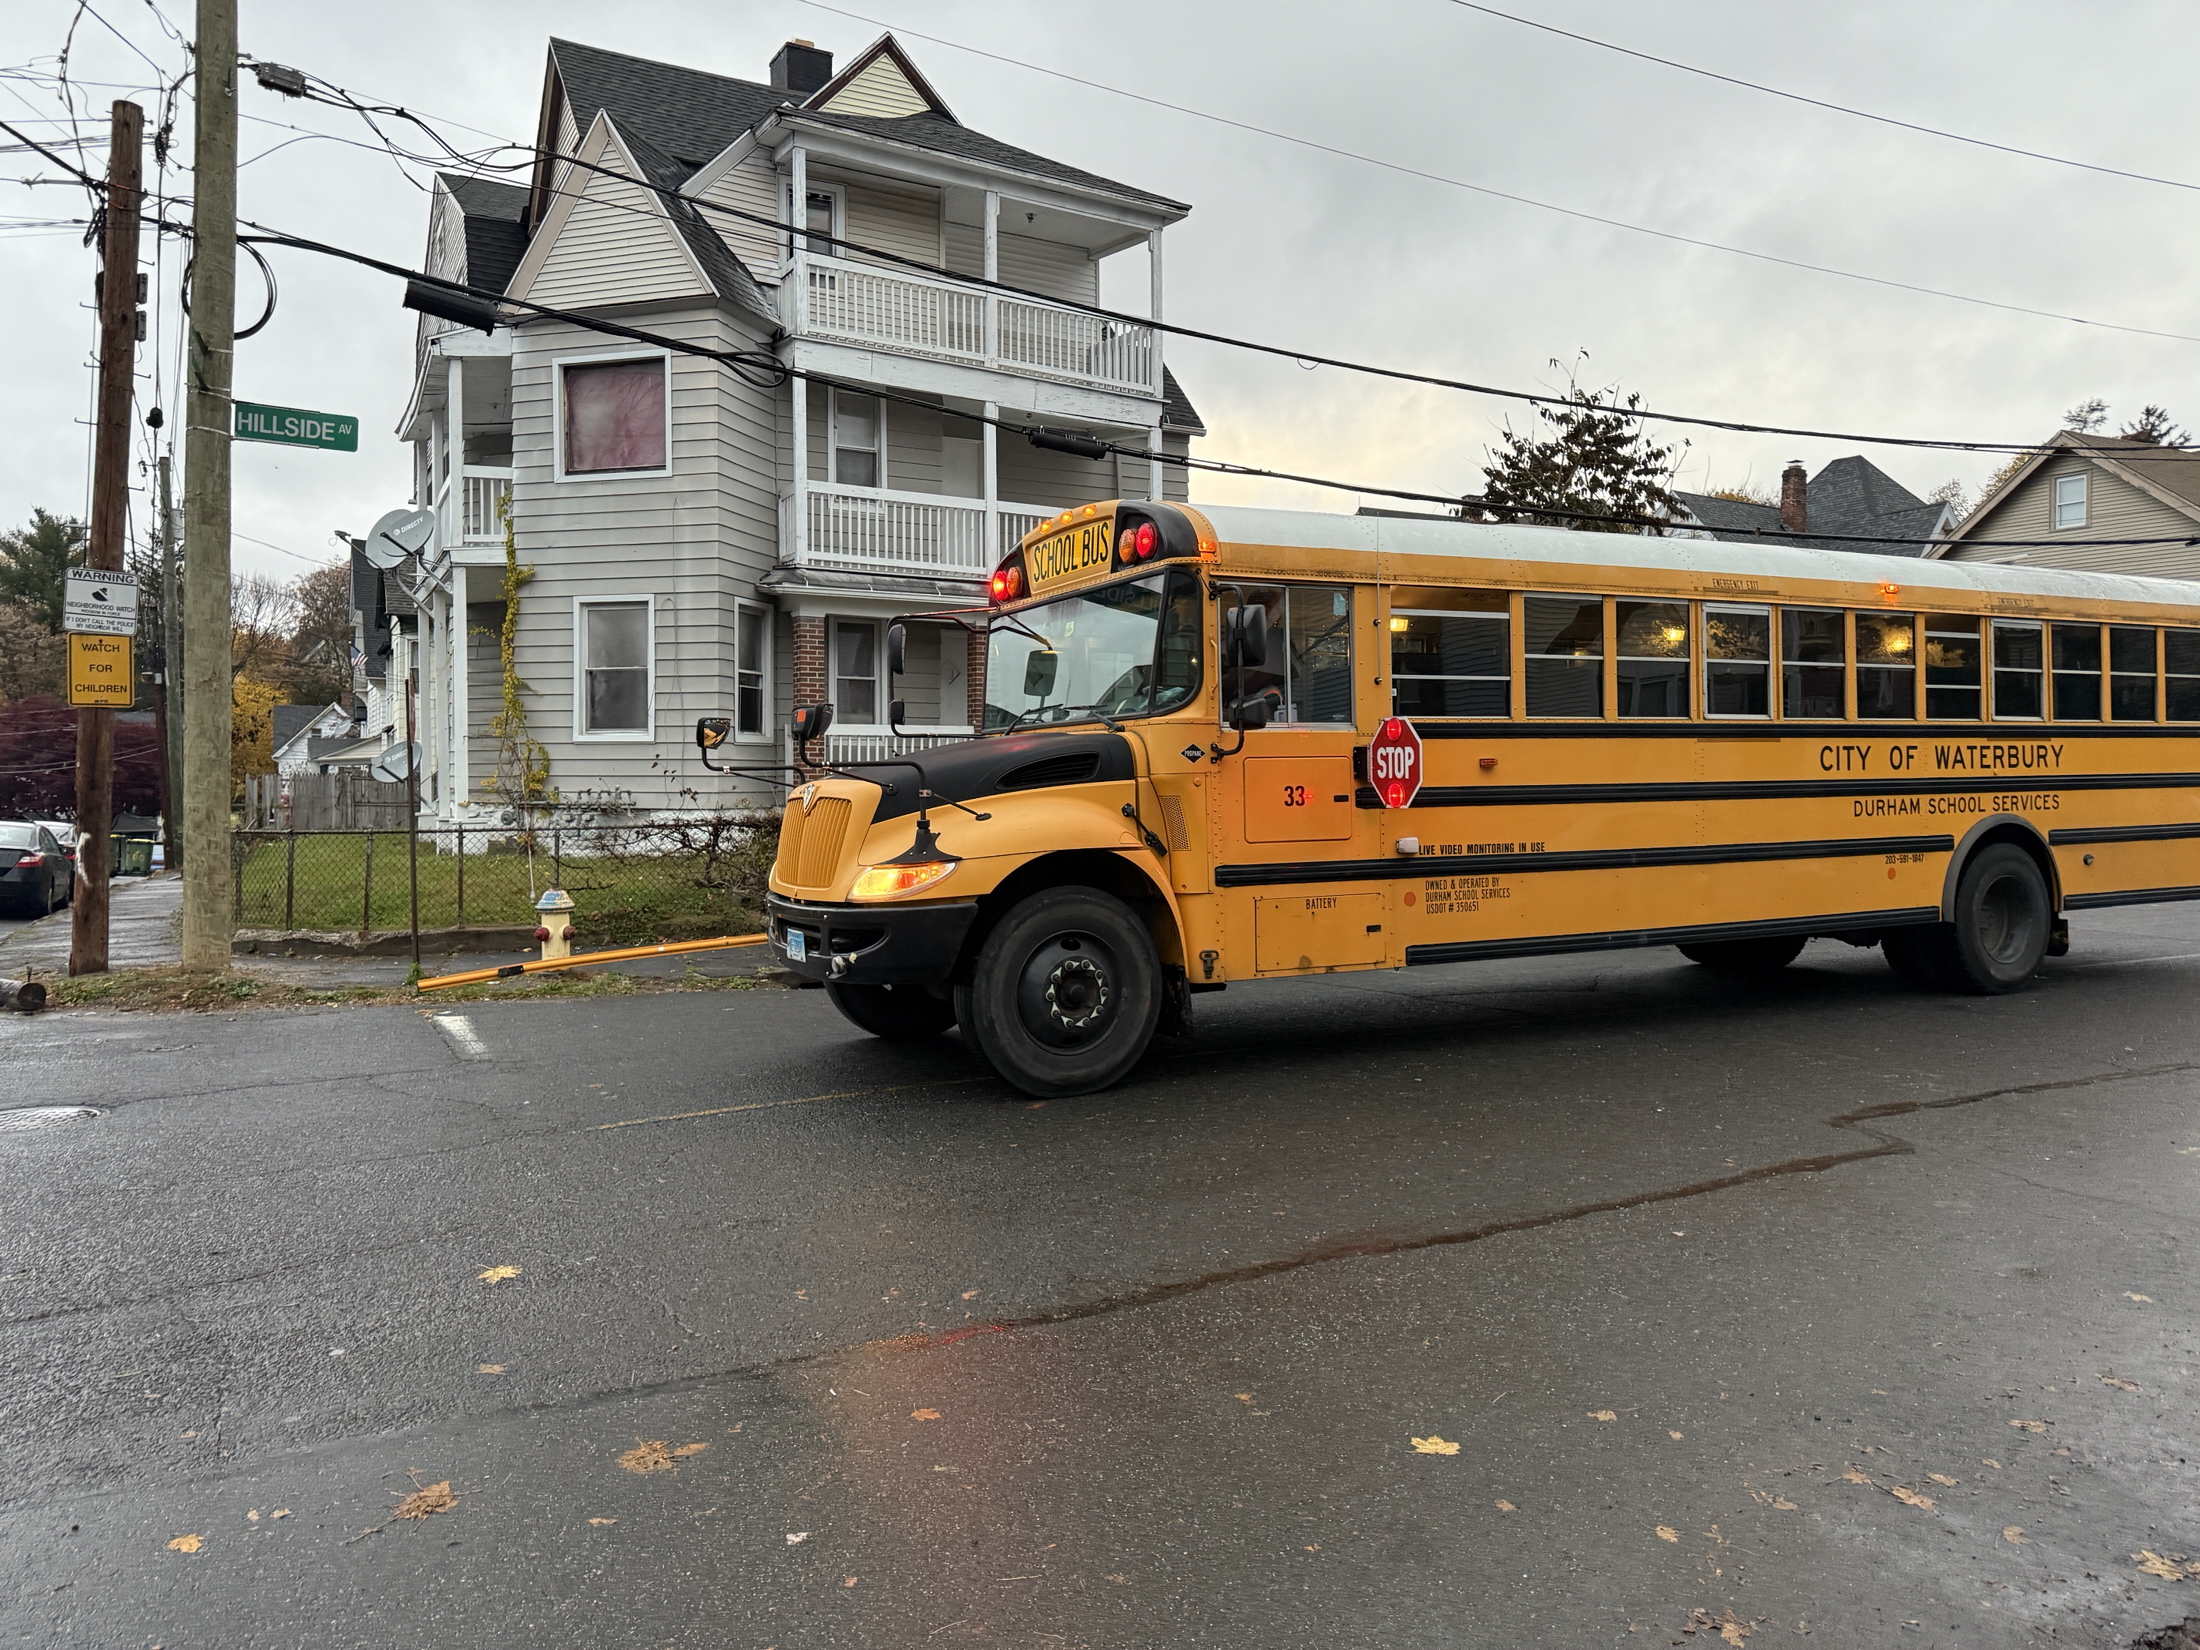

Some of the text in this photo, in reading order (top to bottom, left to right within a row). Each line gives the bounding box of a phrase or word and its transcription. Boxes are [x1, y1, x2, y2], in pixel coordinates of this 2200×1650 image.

[237, 411, 352, 441] HILLSIDE AV
[1033, 521, 1109, 582] SCHOOL BUS
[72, 569, 134, 584] WARNING
[1712, 578, 1759, 590] EMERGENCY EXIT
[66, 601, 136, 613] NEIGHBORHOOD WATCH
[81, 643, 120, 652] WATCH
[89, 664, 112, 672] FOR
[74, 684, 127, 693] CHILDREN
[1376, 746, 1415, 779] STOP
[1820, 744, 2064, 771] CITY OF WATERBURY
[1284, 785, 1306, 807] 33
[1853, 794, 2060, 817] DURHAM SCHOOL SERVICES
[1418, 842, 1545, 856] LIVE VIDEO MONITORING IN USE
[1425, 877, 1500, 891] OWNED & OPERATED BY
[1425, 888, 1510, 902] DURHAM SCHOOL SERVICES
[1306, 897, 1337, 910] BATTERY
[1426, 901, 1479, 914] USDOT # 350651
